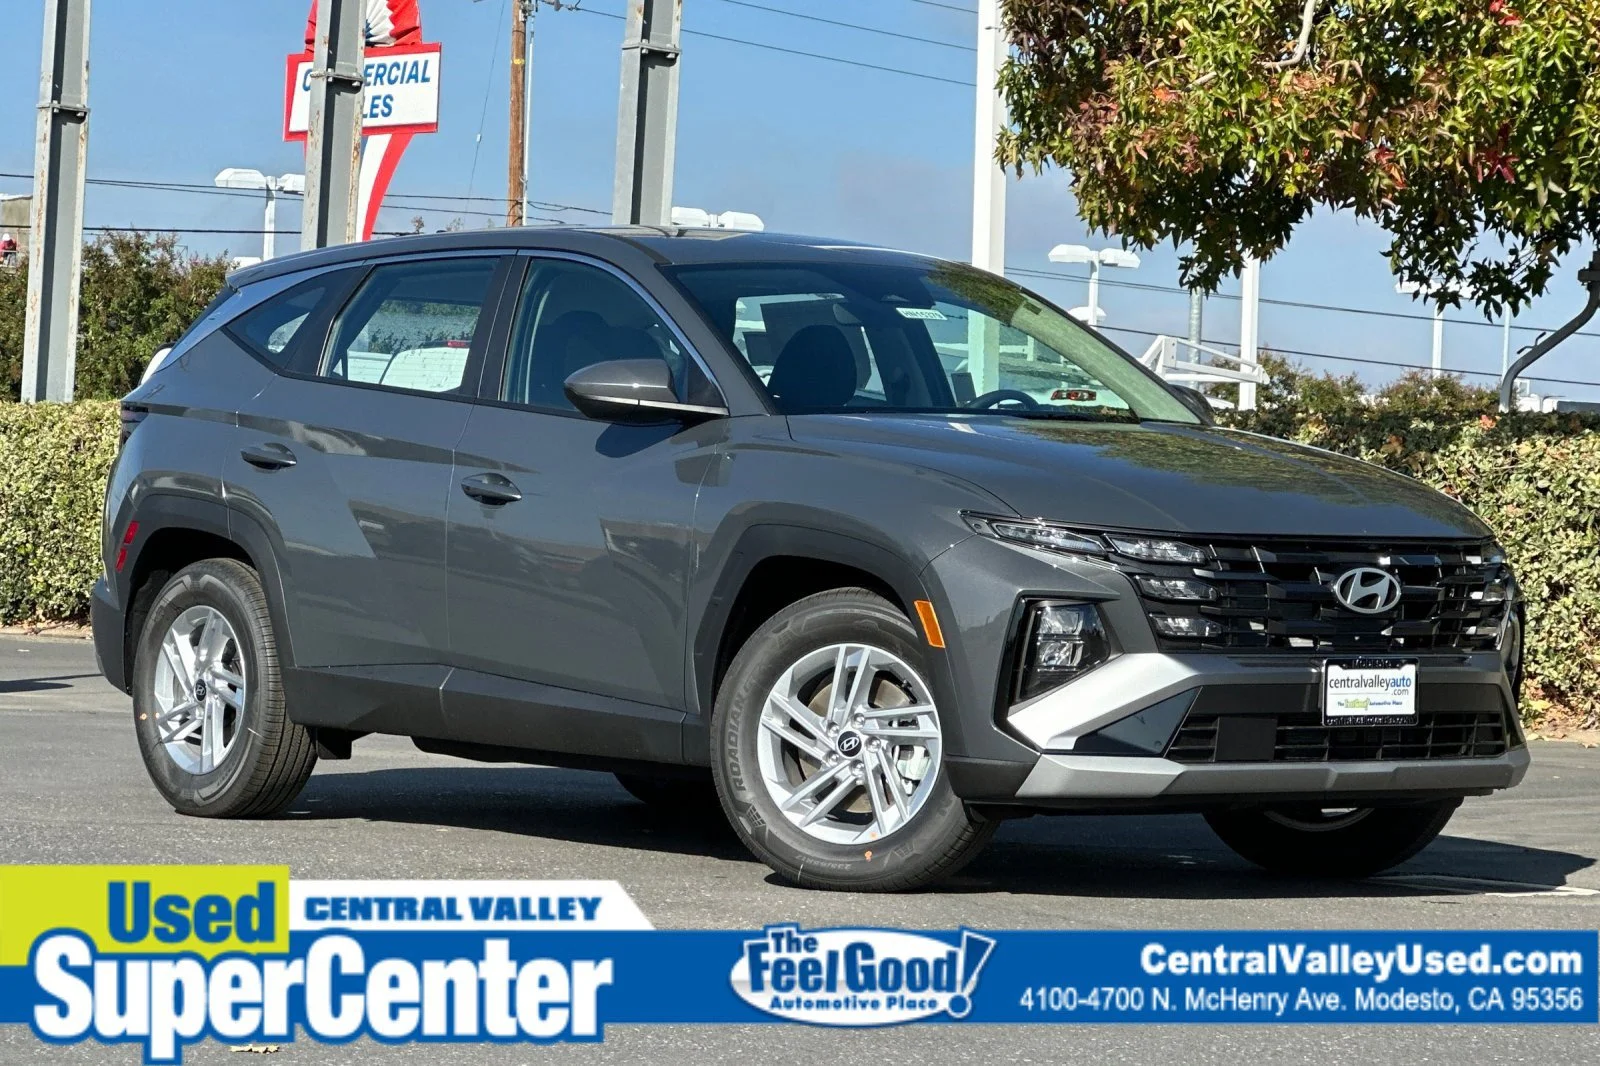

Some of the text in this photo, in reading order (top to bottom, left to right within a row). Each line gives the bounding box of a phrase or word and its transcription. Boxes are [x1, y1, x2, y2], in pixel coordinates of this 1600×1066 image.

[302, 59, 431, 92] CERCIAL
[1329, 674, 1412, 691] centralvalleyauto
[1391, 688, 1409, 696] .com
